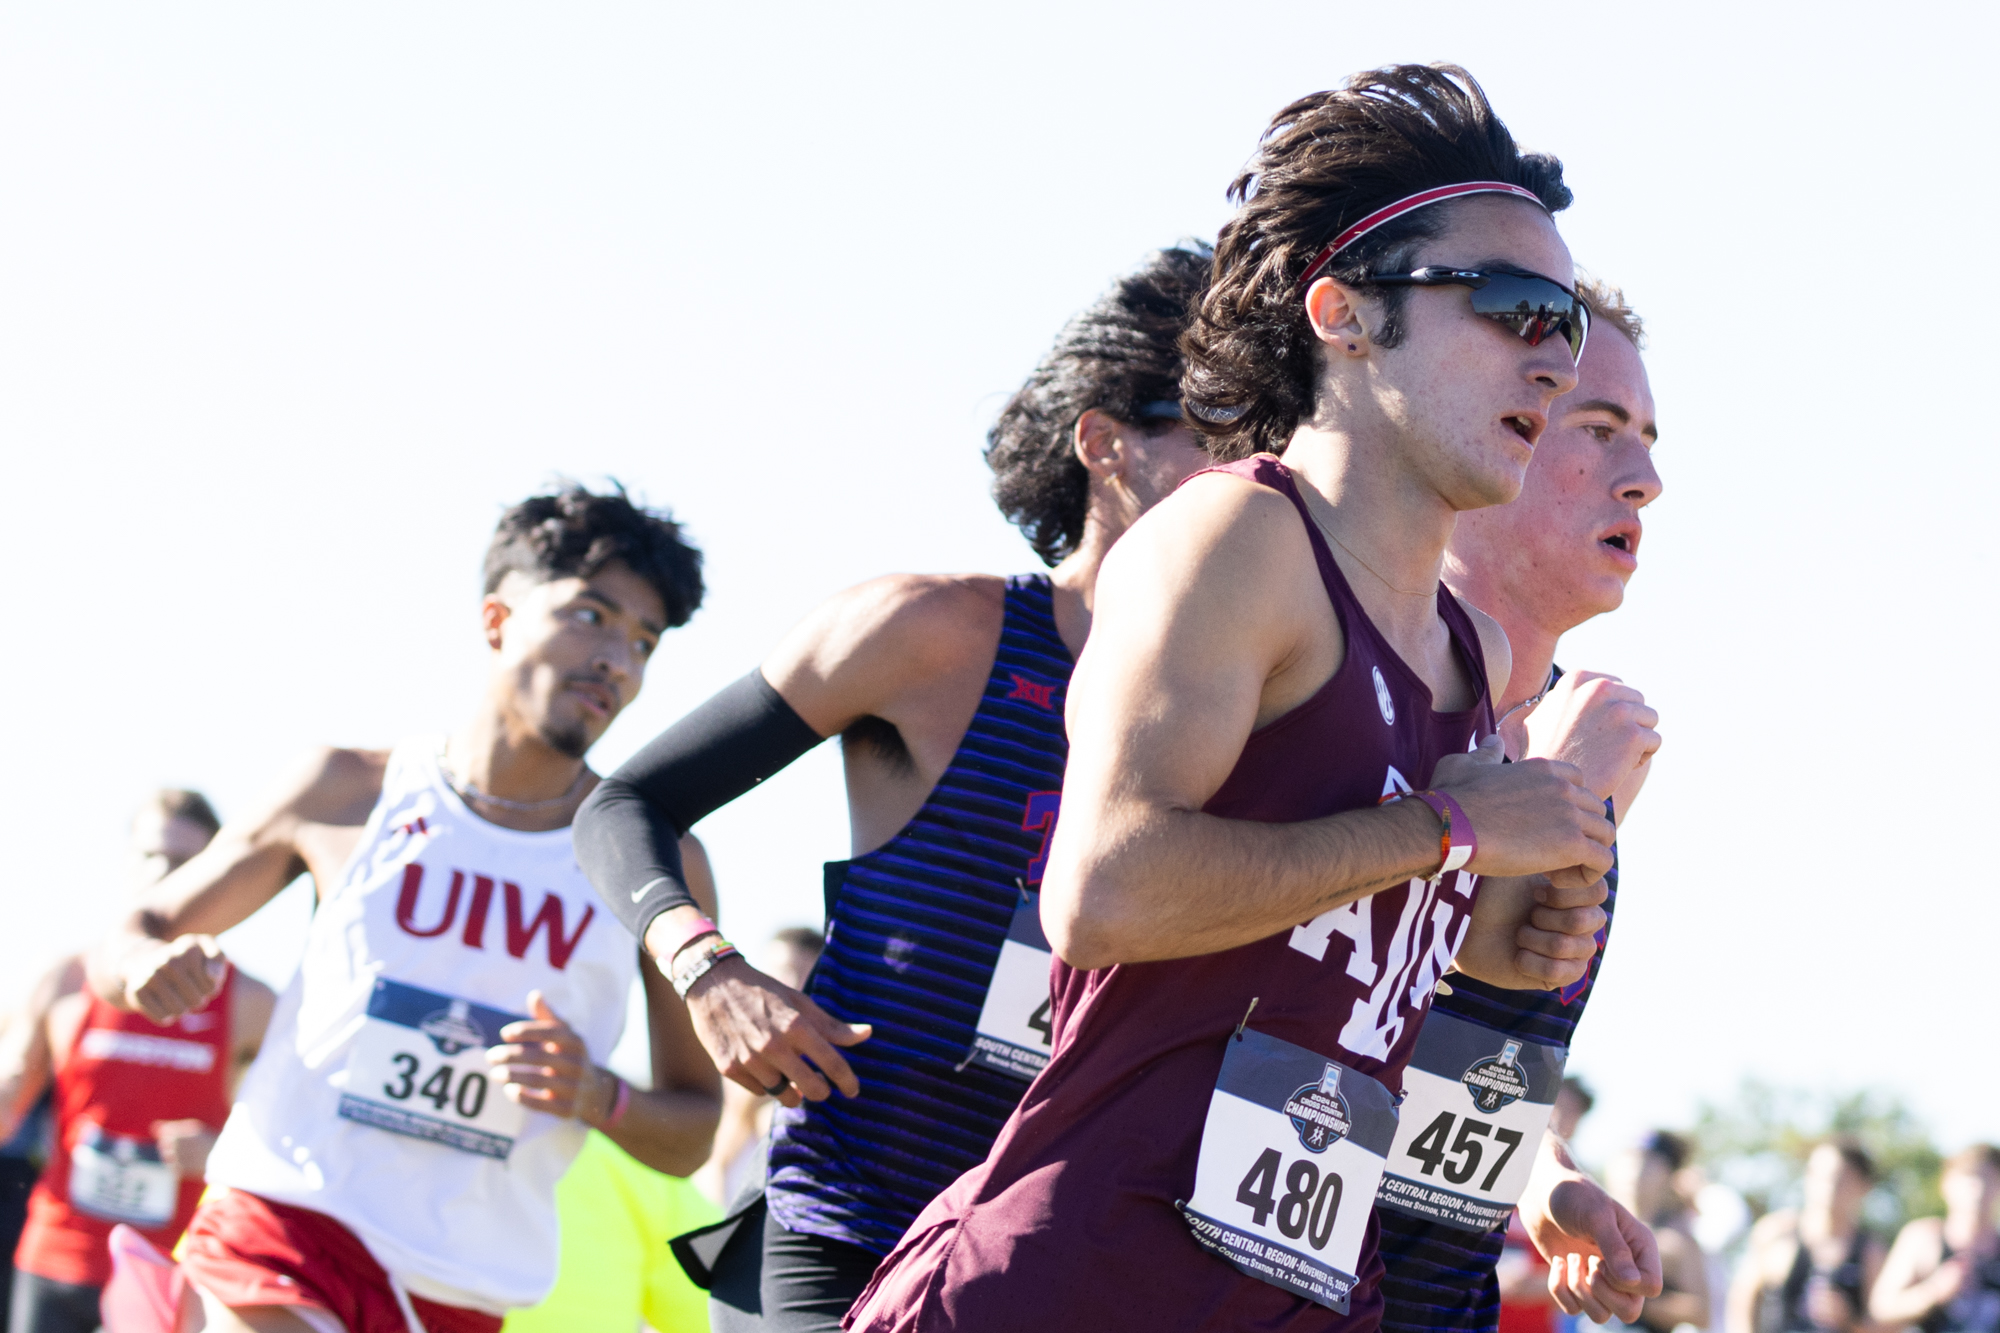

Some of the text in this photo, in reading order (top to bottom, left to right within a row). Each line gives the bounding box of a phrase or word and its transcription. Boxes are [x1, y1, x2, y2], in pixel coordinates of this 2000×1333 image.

[395, 863, 594, 970] UIW
[1010, 1049, 1048, 1069] CENTRA
[384, 1053, 488, 1119] 340
[1463, 1071, 1526, 1098] CHAMPIONSHIPS
[1285, 1101, 1349, 1135] CHAMPIONSHIPS
[1300, 1097, 1344, 1119] CROSS COUNTRY
[1406, 1110, 1524, 1192] 457
[1236, 1147, 1343, 1250] 480
[1386, 1179, 1429, 1201] CENTRAL
[1440, 1208, 1450, 1219] TX
[1455, 1212, 1476, 1226] Texas
[1184, 1212, 1223, 1239] SOUTH
[1221, 1230, 1264, 1257] CENTRAL
[1334, 1279, 1349, 1292] 2024
[1275, 1267, 1286, 1279] TX
[1289, 1273, 1309, 1289] Texas
[1325, 1288, 1339, 1302] Host
